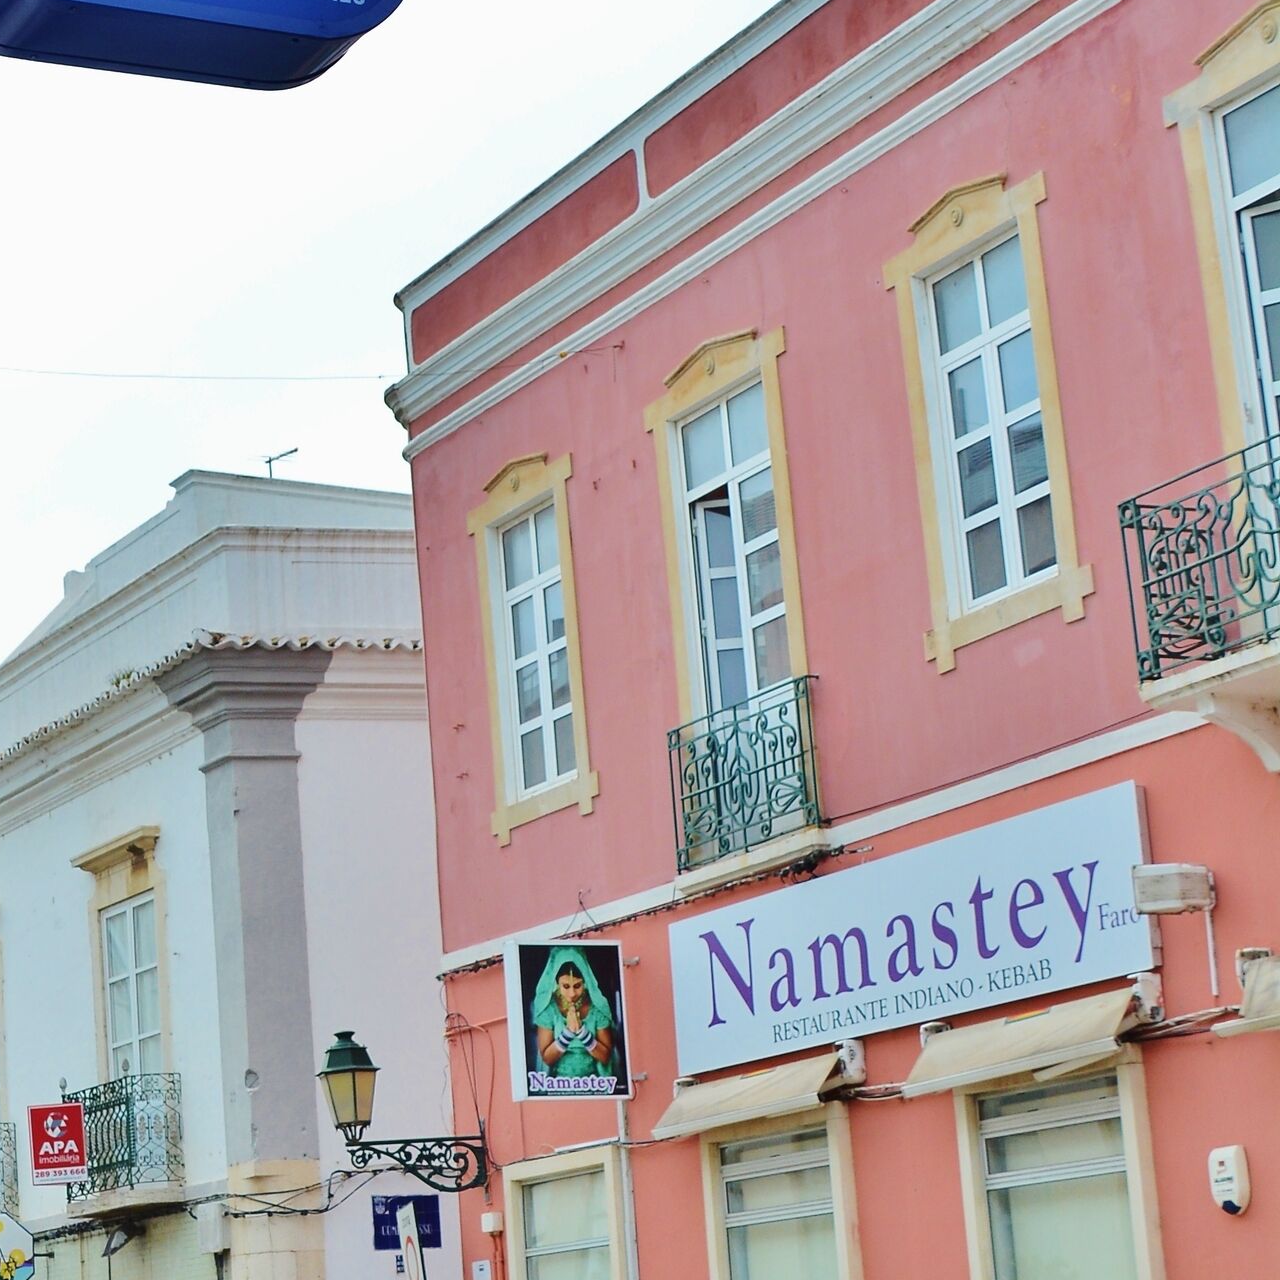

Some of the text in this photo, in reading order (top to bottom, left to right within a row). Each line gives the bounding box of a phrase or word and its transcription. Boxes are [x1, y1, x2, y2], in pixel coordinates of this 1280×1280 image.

[698, 860, 1100, 1028] Namastey
[772, 997, 890, 1044] RESTAURANTE
[893, 976, 975, 1015] INDIANO
[987, 958, 1053, 993] KEBAB
[528, 1072, 617, 1094] Namastey
[39, 1139, 79, 1155] APA
[35, 1170, 51, 1178] 289
[53, 1168, 68, 1177] 393
